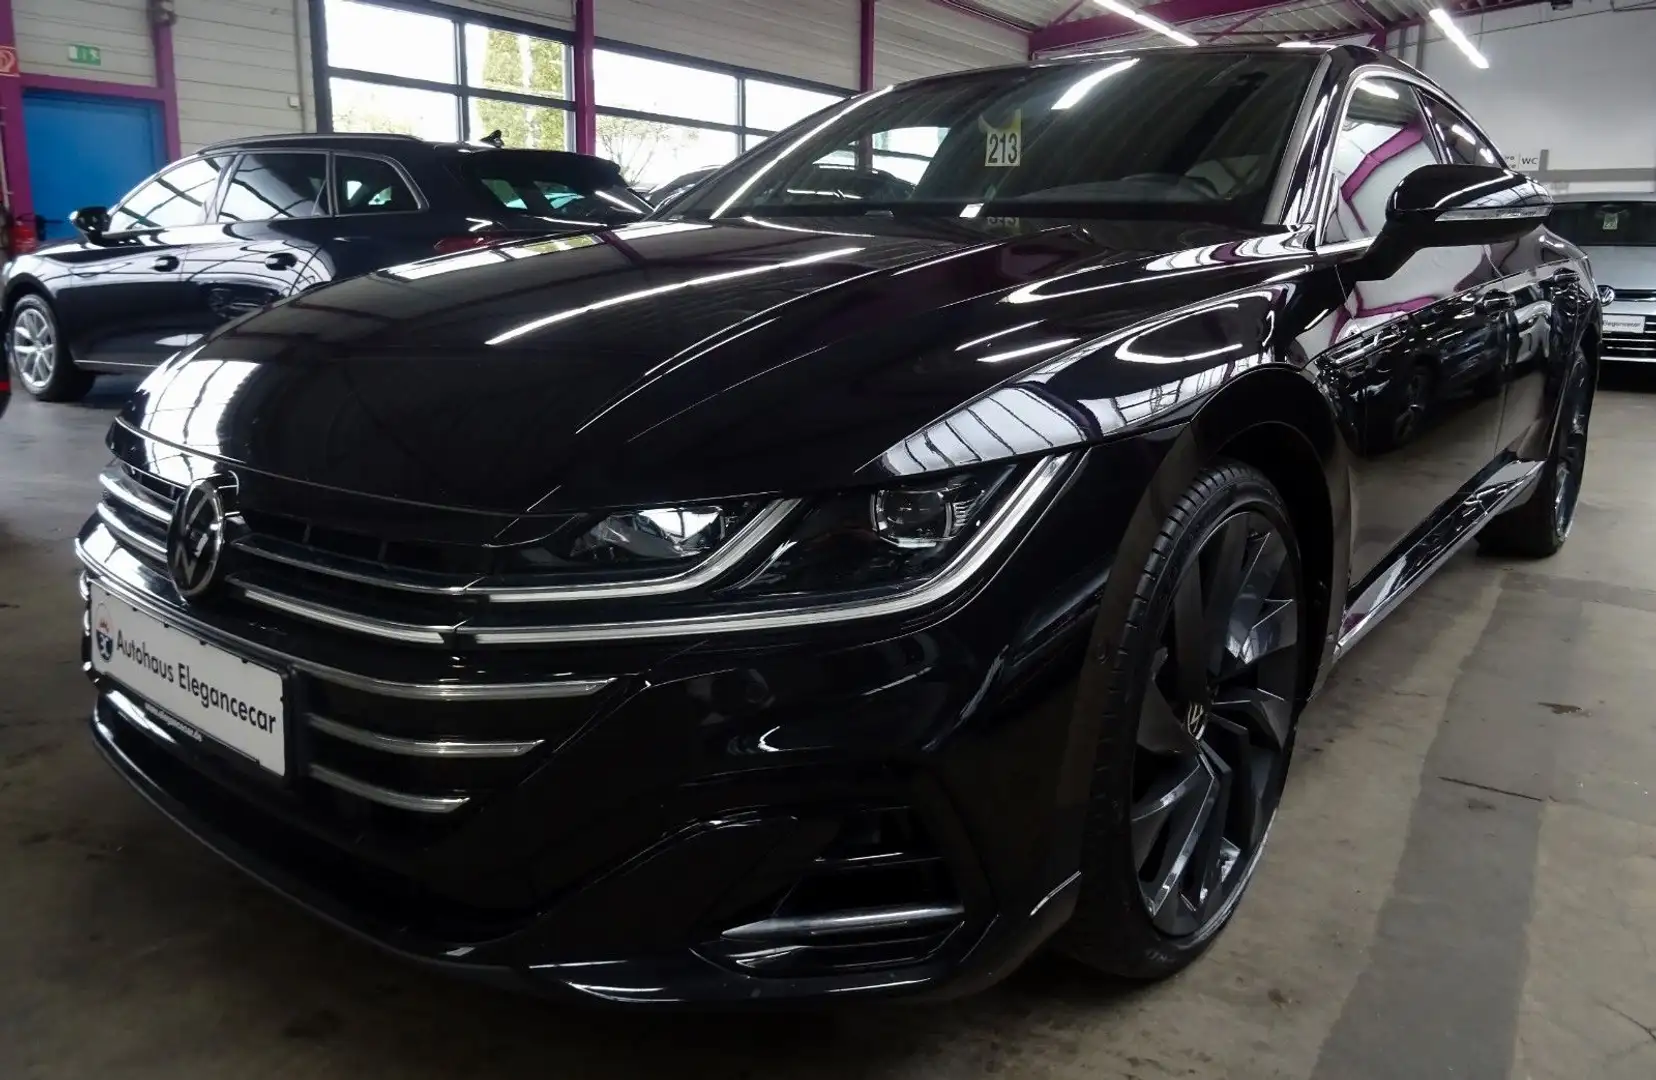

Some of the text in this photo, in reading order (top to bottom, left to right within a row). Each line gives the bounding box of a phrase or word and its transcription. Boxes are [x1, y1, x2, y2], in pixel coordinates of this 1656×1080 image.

[988, 132, 1018, 164] 213
[1521, 157, 1538, 165] WC
[116, 629, 174, 684] Autohaus
[178, 662, 276, 734] Elegancecar
